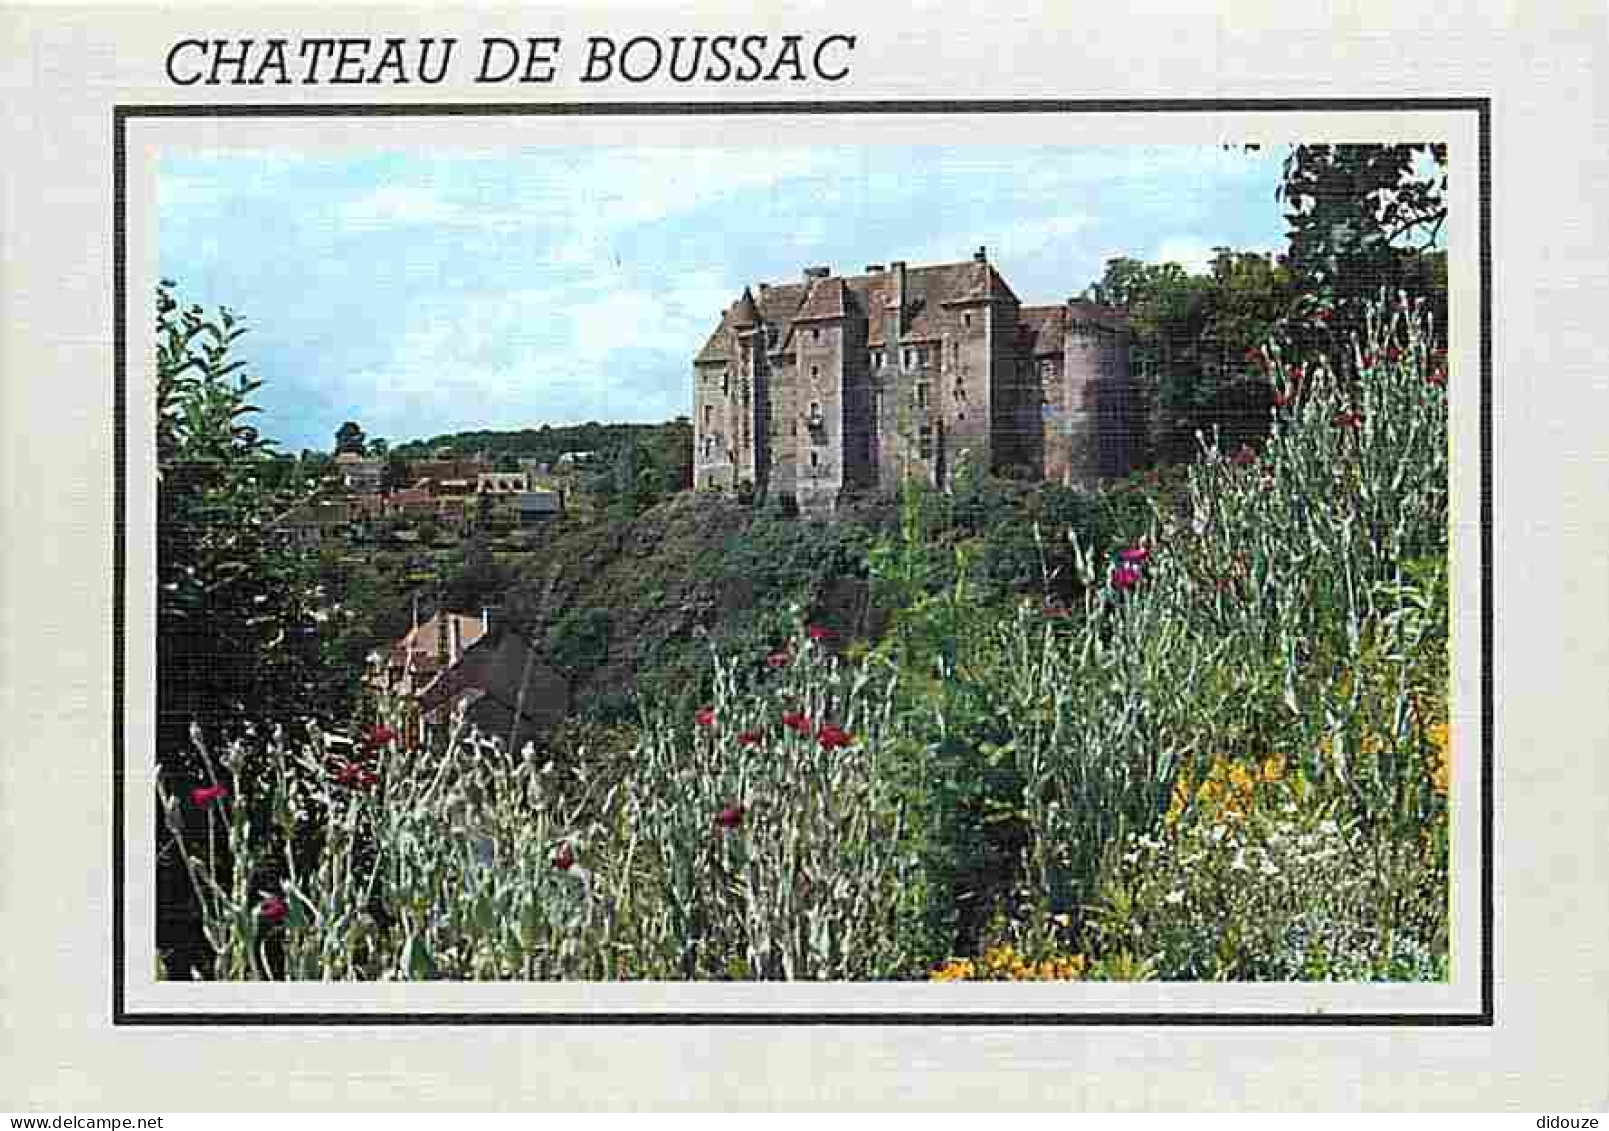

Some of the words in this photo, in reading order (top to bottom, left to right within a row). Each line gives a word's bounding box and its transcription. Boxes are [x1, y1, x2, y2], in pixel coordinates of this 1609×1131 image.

[165, 37, 457, 86] CHATEAU
[474, 37, 561, 83] DE
[579, 34, 857, 83] BOUSSAC
